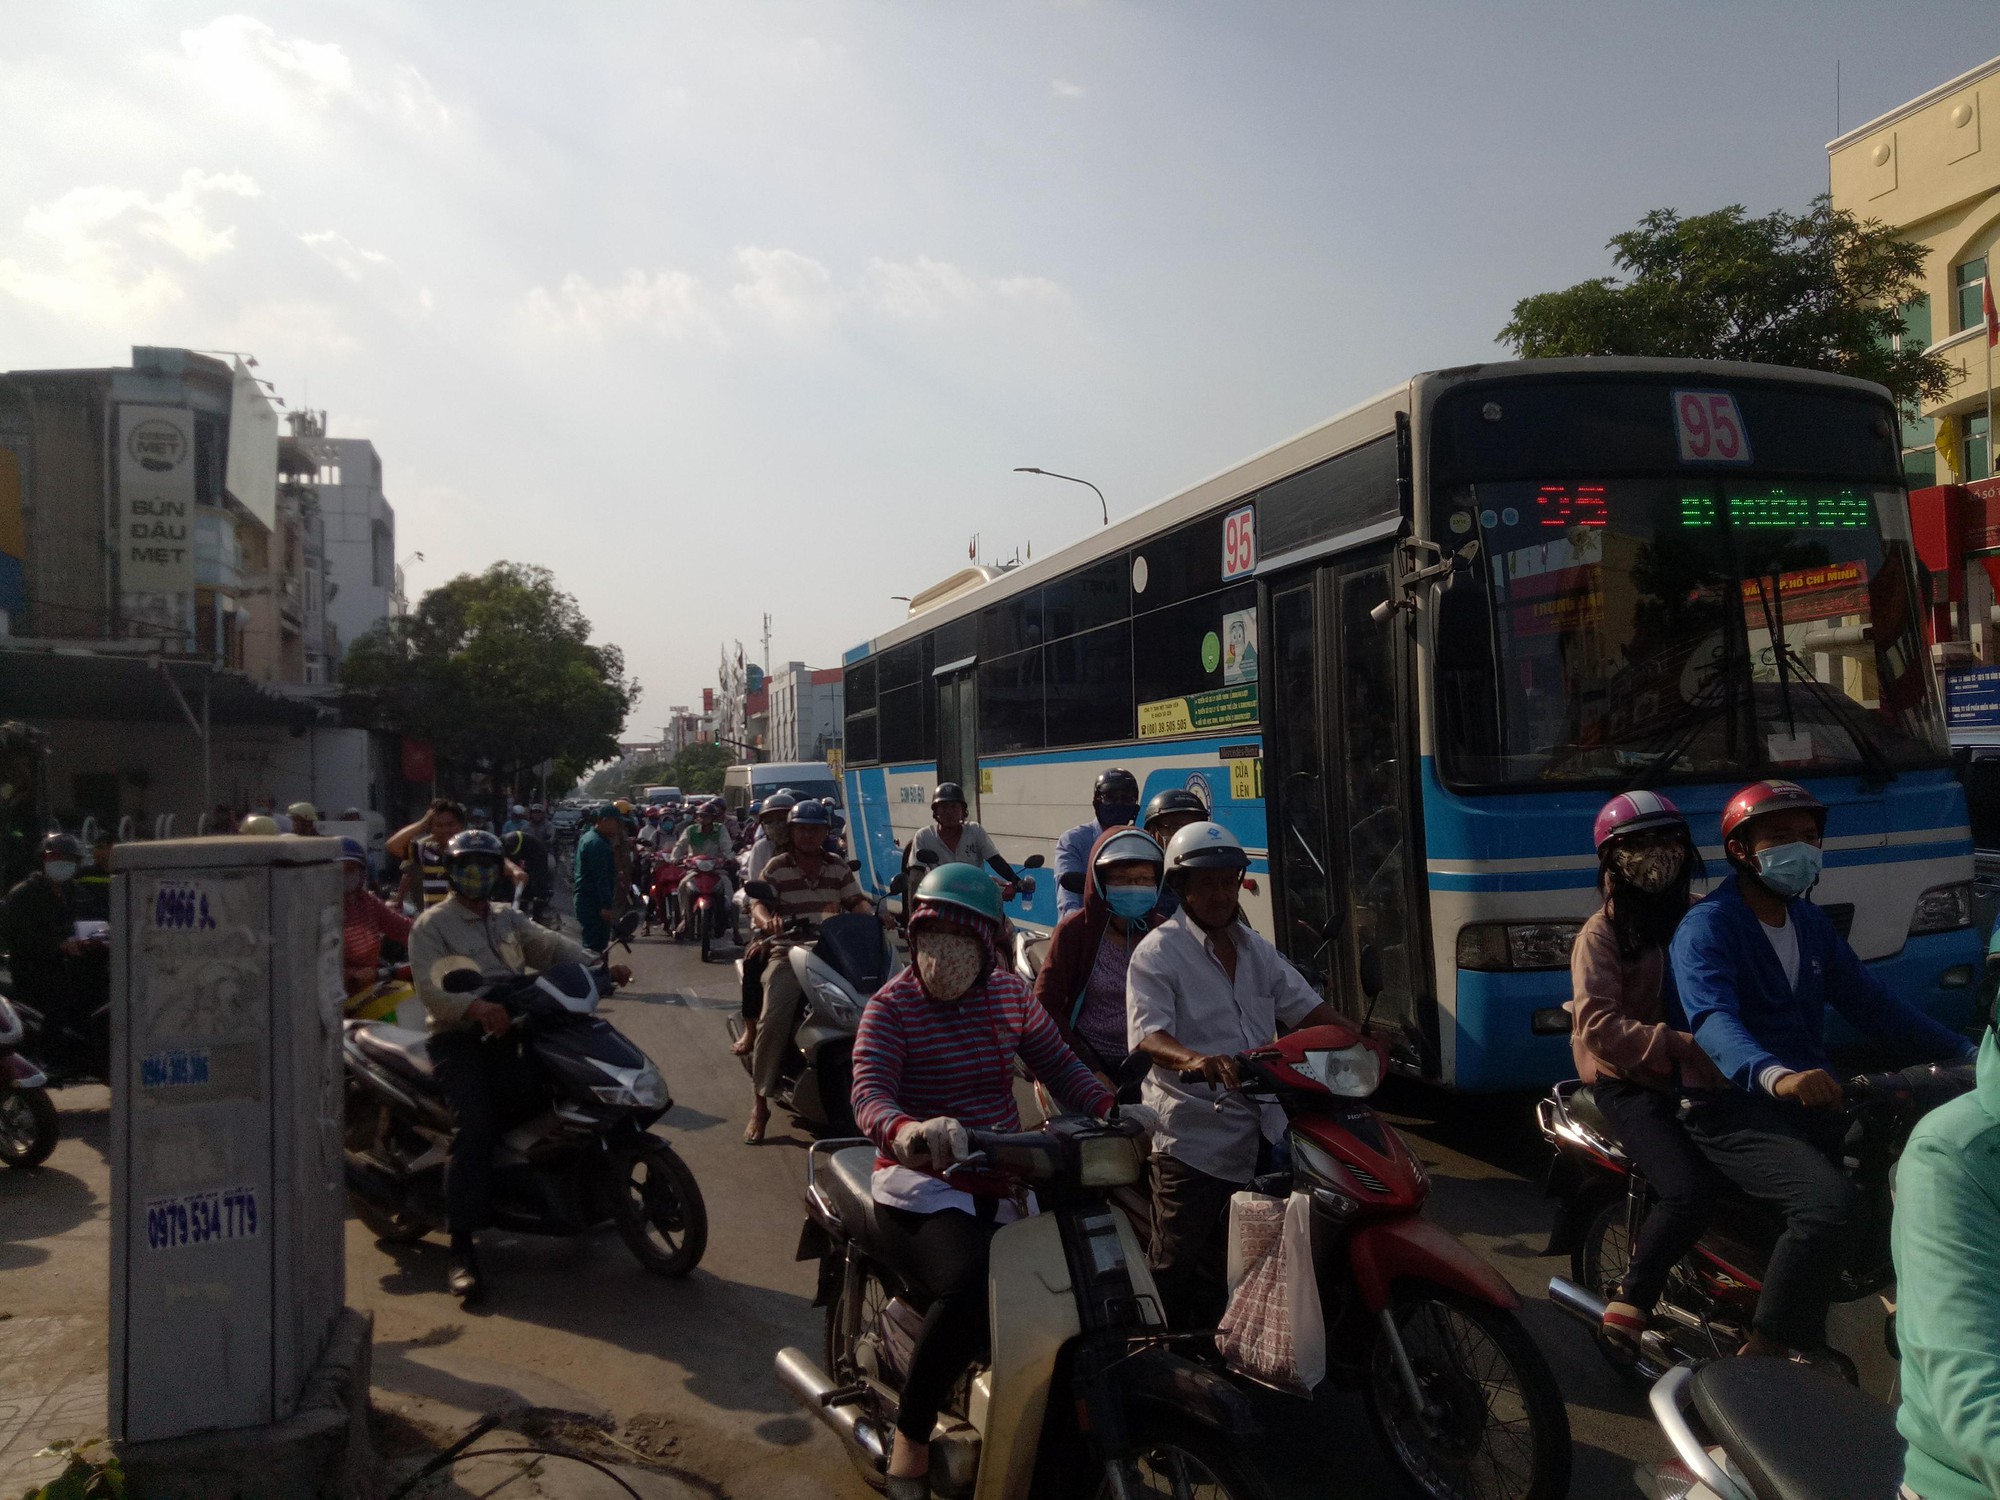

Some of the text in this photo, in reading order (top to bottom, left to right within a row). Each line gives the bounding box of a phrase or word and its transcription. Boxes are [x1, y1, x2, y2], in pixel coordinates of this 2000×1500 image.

[1680, 393, 1741, 460] 95
[131, 496, 185, 518] BÚN
[130, 520, 186, 543] ĐẬU
[1225, 512, 1252, 574] 95
[131, 547, 186, 566] MẸT
[1827, 567, 1858, 582] MINH
[1235, 781, 1250, 798] LÊN
[148, 1204, 188, 1249] 0979
[190, 1199, 221, 1243] 534
[223, 1194, 258, 1238] 779
